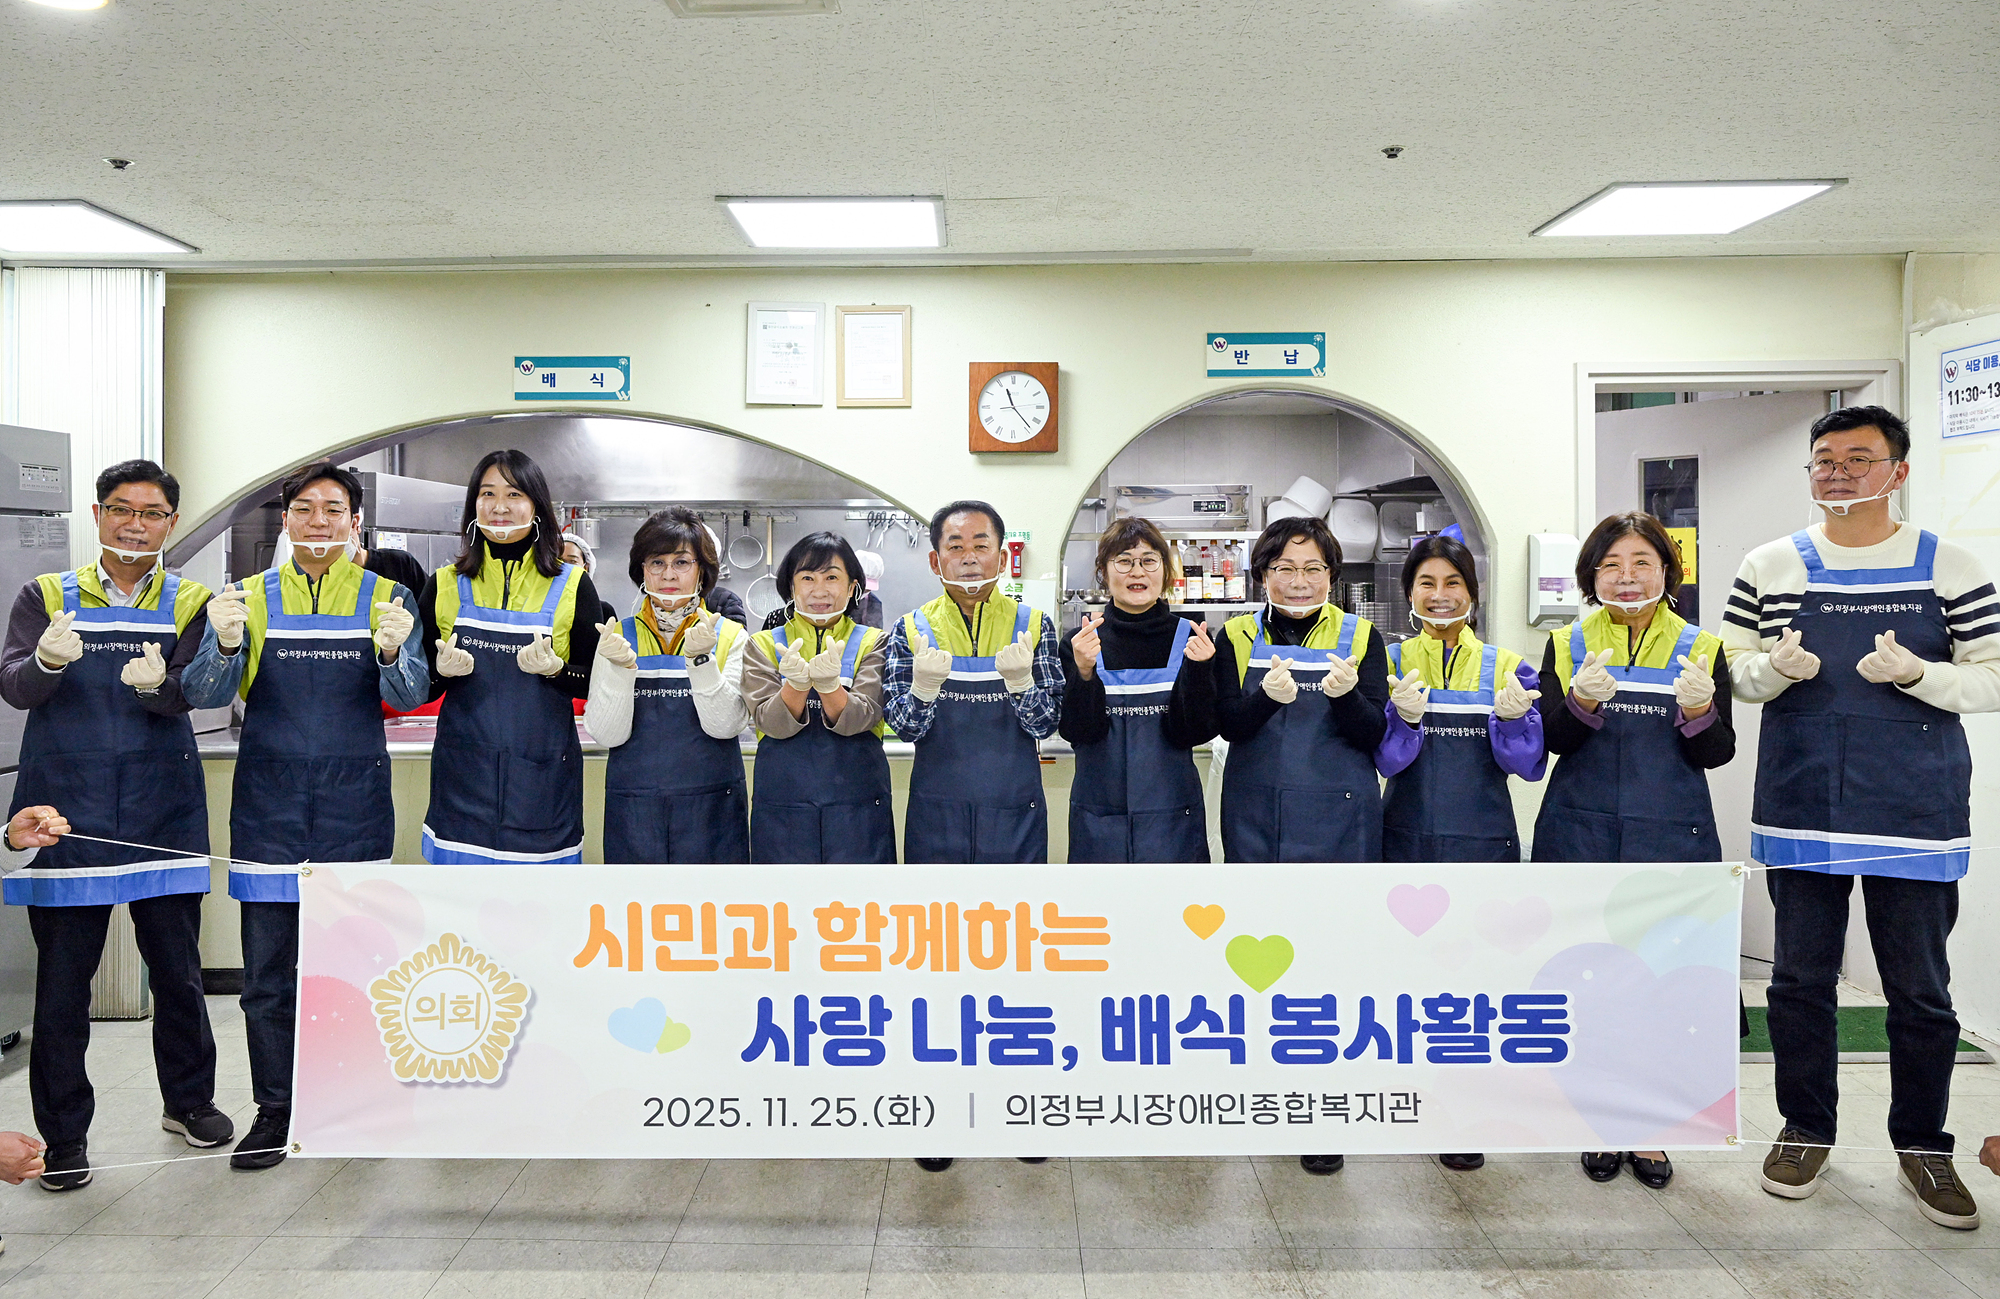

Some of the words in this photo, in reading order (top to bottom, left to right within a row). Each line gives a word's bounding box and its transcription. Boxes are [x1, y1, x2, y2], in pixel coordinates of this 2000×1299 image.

[1965, 359, 1981, 372] 식당
[1983, 354, 2000, 369] 이용
[1005, 583, 1023, 593] 소금
[1834, 603, 1923, 614] 의정부시장애인종합복지관
[83, 642, 144, 653] 의정부시장애인종합
[289, 650, 361, 660] 의정부시장애인종합복지관
[948, 691, 1010, 703] 의정부시장애인종합복지
[573, 901, 798, 972] 시민과
[812, 900, 1112, 972] 함께하는
[413, 993, 481, 1030] 의회
[740, 994, 893, 1067] 사랑
[912, 994, 1079, 1072] 나눔,
[1101, 993, 1246, 1065] 배식
[1268, 992, 1571, 1065] 봉사활동
[643, 1097, 751, 1128] 2025.
[763, 1097, 798, 1127] 11.
[810, 1094, 935, 1128] 25.(화)
[1005, 1091, 1422, 1128] 의정부시장애인종합복지관
